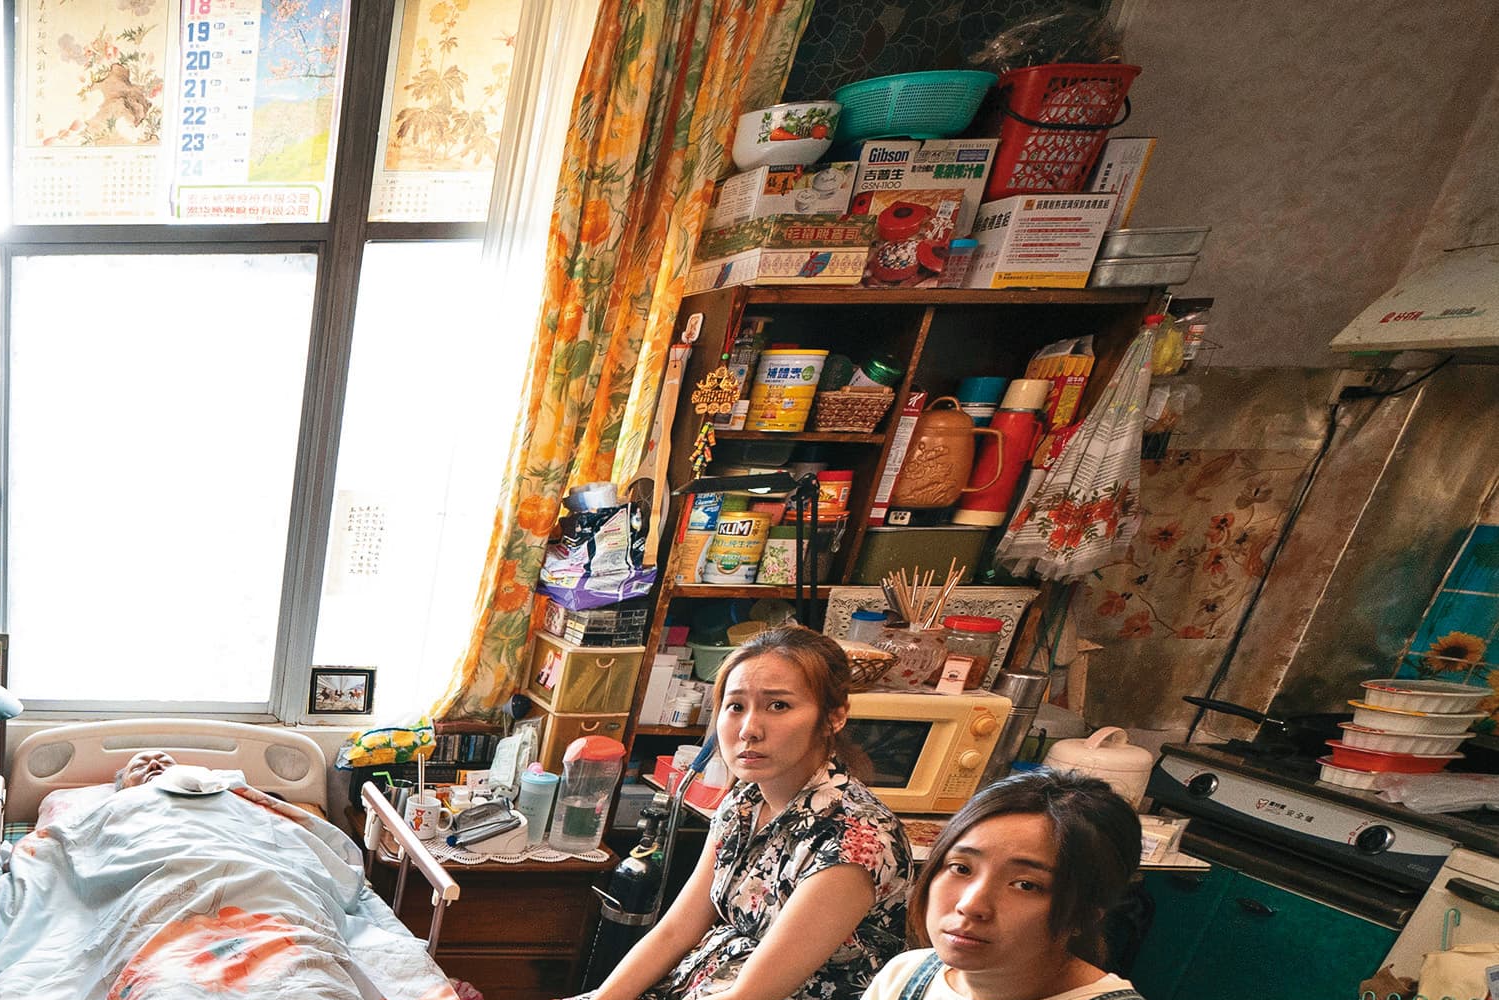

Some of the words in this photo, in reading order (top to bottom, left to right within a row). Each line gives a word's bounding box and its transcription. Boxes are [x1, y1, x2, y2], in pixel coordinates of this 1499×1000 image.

[189, 0, 211, 15] 18
[187, 21, 210, 42] 19
[186, 50, 210, 71] 20
[184, 79, 206, 98] 21
[182, 106, 207, 126] 22
[181, 133, 205, 151] 23
[868, 147, 910, 162] Gibson
[863, 169, 906, 181] 吉普生
[861, 180, 902, 190] GSN-1100
[719, 519, 753, 536] KLIM
